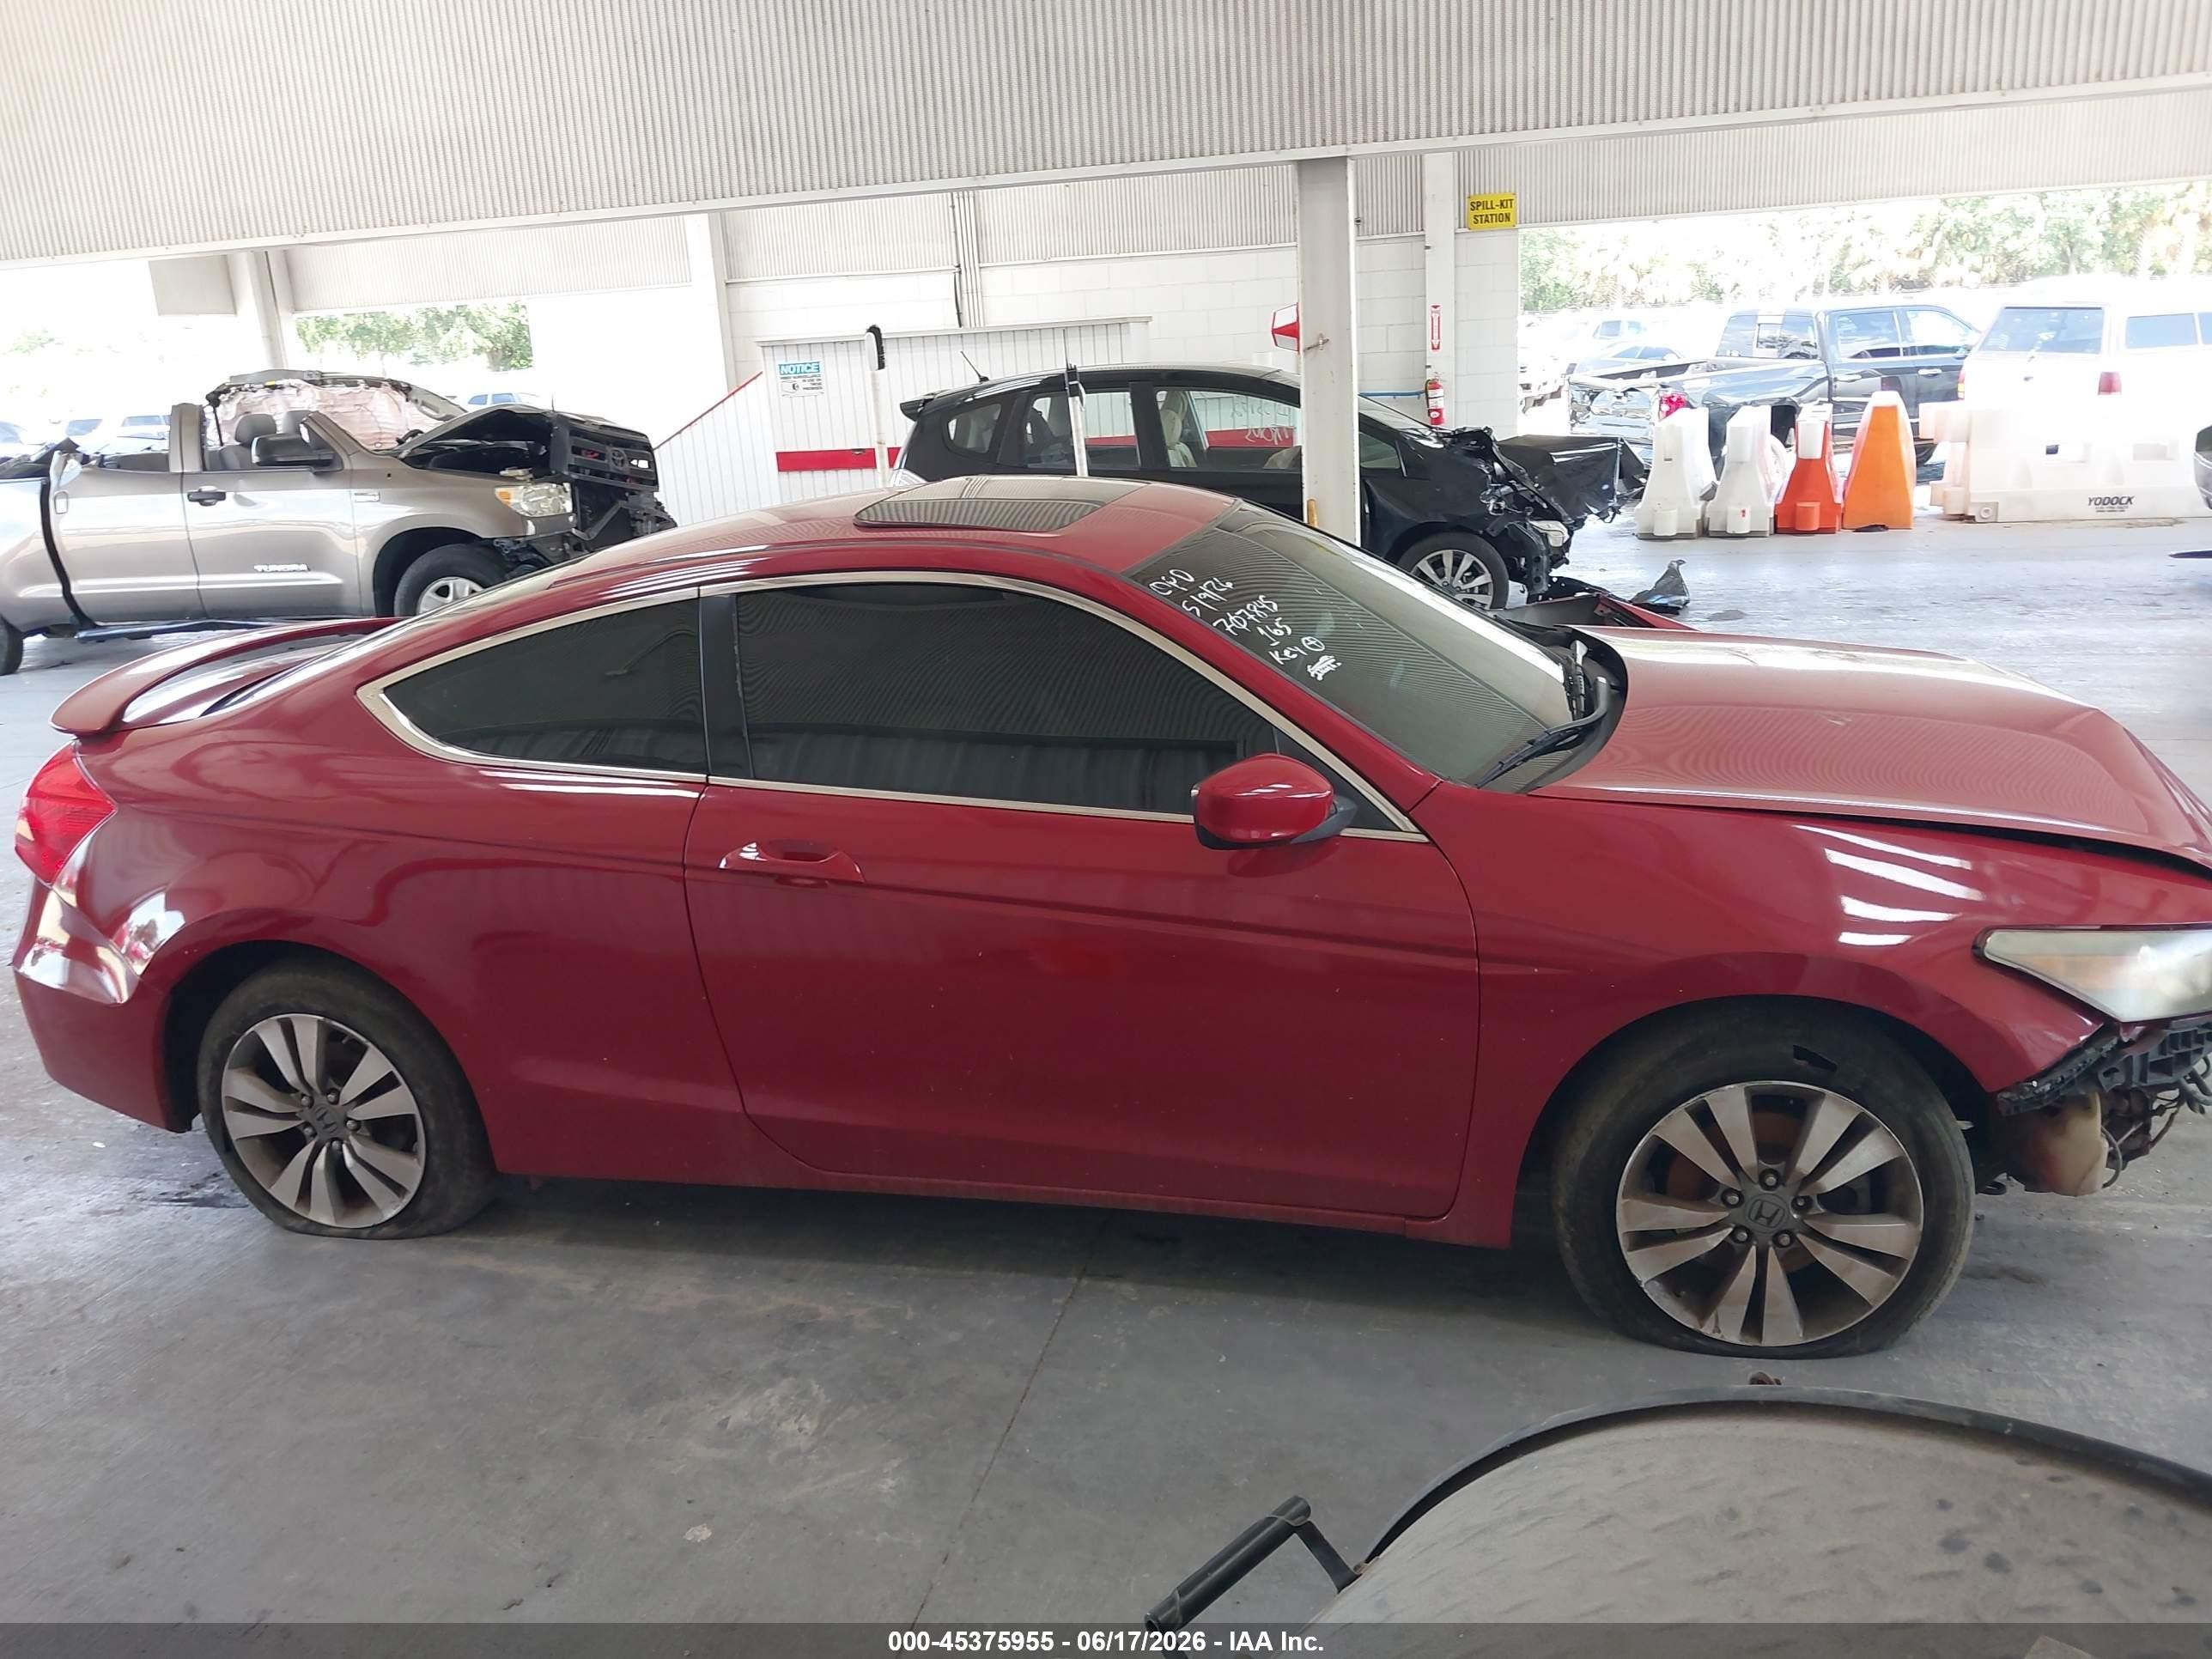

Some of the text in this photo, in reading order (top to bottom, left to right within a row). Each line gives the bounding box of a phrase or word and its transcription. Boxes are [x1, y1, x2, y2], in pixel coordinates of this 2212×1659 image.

[1470, 199, 1514, 211] SPILL-KIT
[1473, 212, 1511, 224] STATION
[781, 363, 819, 374] NOTICE
[2087, 495, 2135, 506] YODOCK
[1257, 617, 1291, 647] 165
